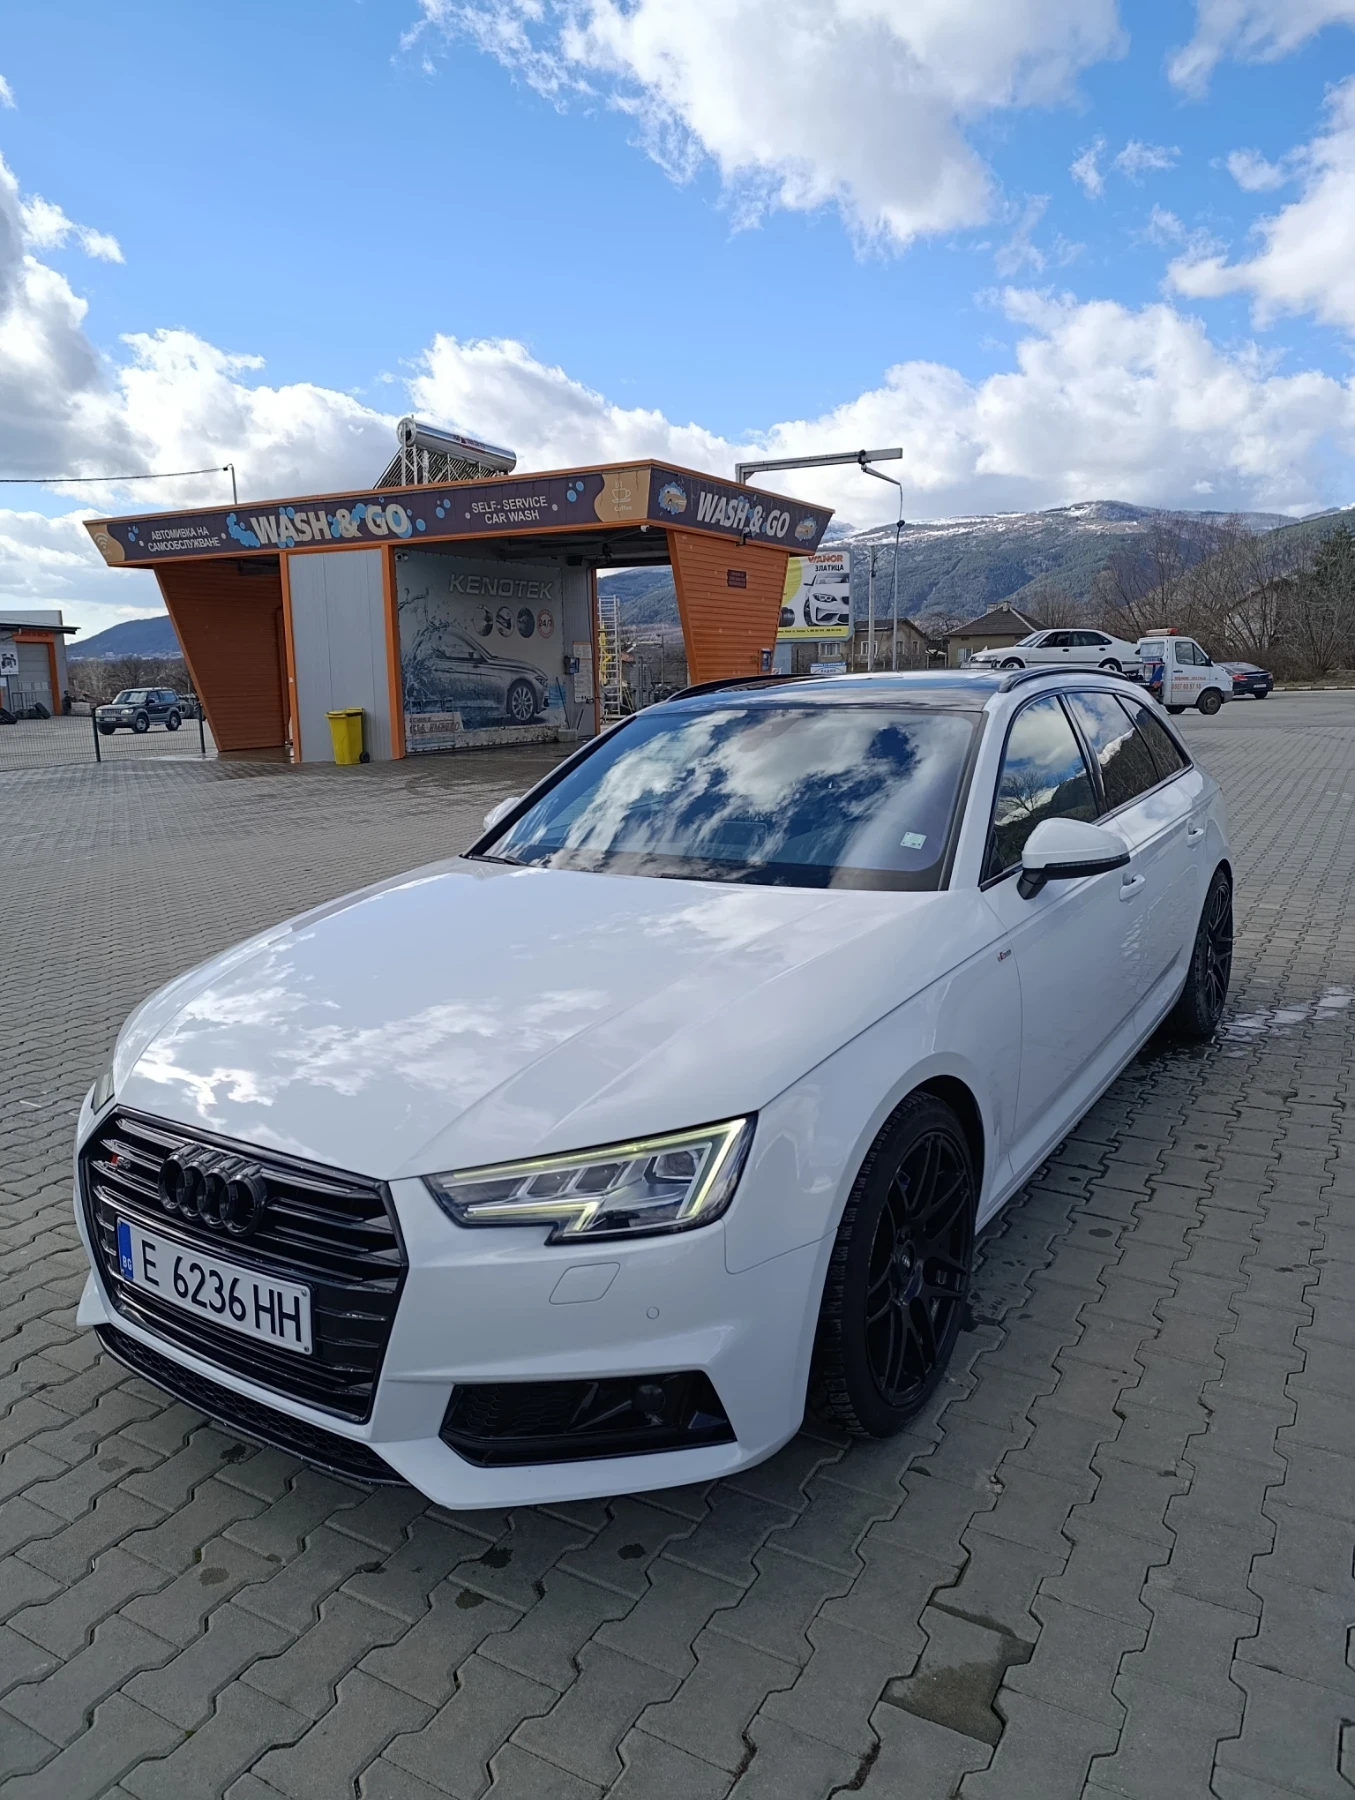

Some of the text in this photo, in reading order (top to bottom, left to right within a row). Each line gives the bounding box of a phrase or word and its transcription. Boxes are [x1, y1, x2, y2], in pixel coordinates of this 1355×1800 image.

[503, 496, 548, 510] SERVICE
[614, 504, 632, 512] Coffee
[485, 509, 540, 524] CAR WASH
[697, 491, 790, 538] WASH & GO
[249, 503, 408, 545] WASH & GO
[151, 526, 209, 541] АВТОМИВКА НА
[147, 537, 221, 552] САМООБСЛУЖВАНЕ
[815, 564, 844, 572] ЗЛАТИЦА
[449, 573, 553, 600] KENOTEK
[122, 1254, 133, 1271] BG
[141, 1239, 302, 1343] E 6236 HH
